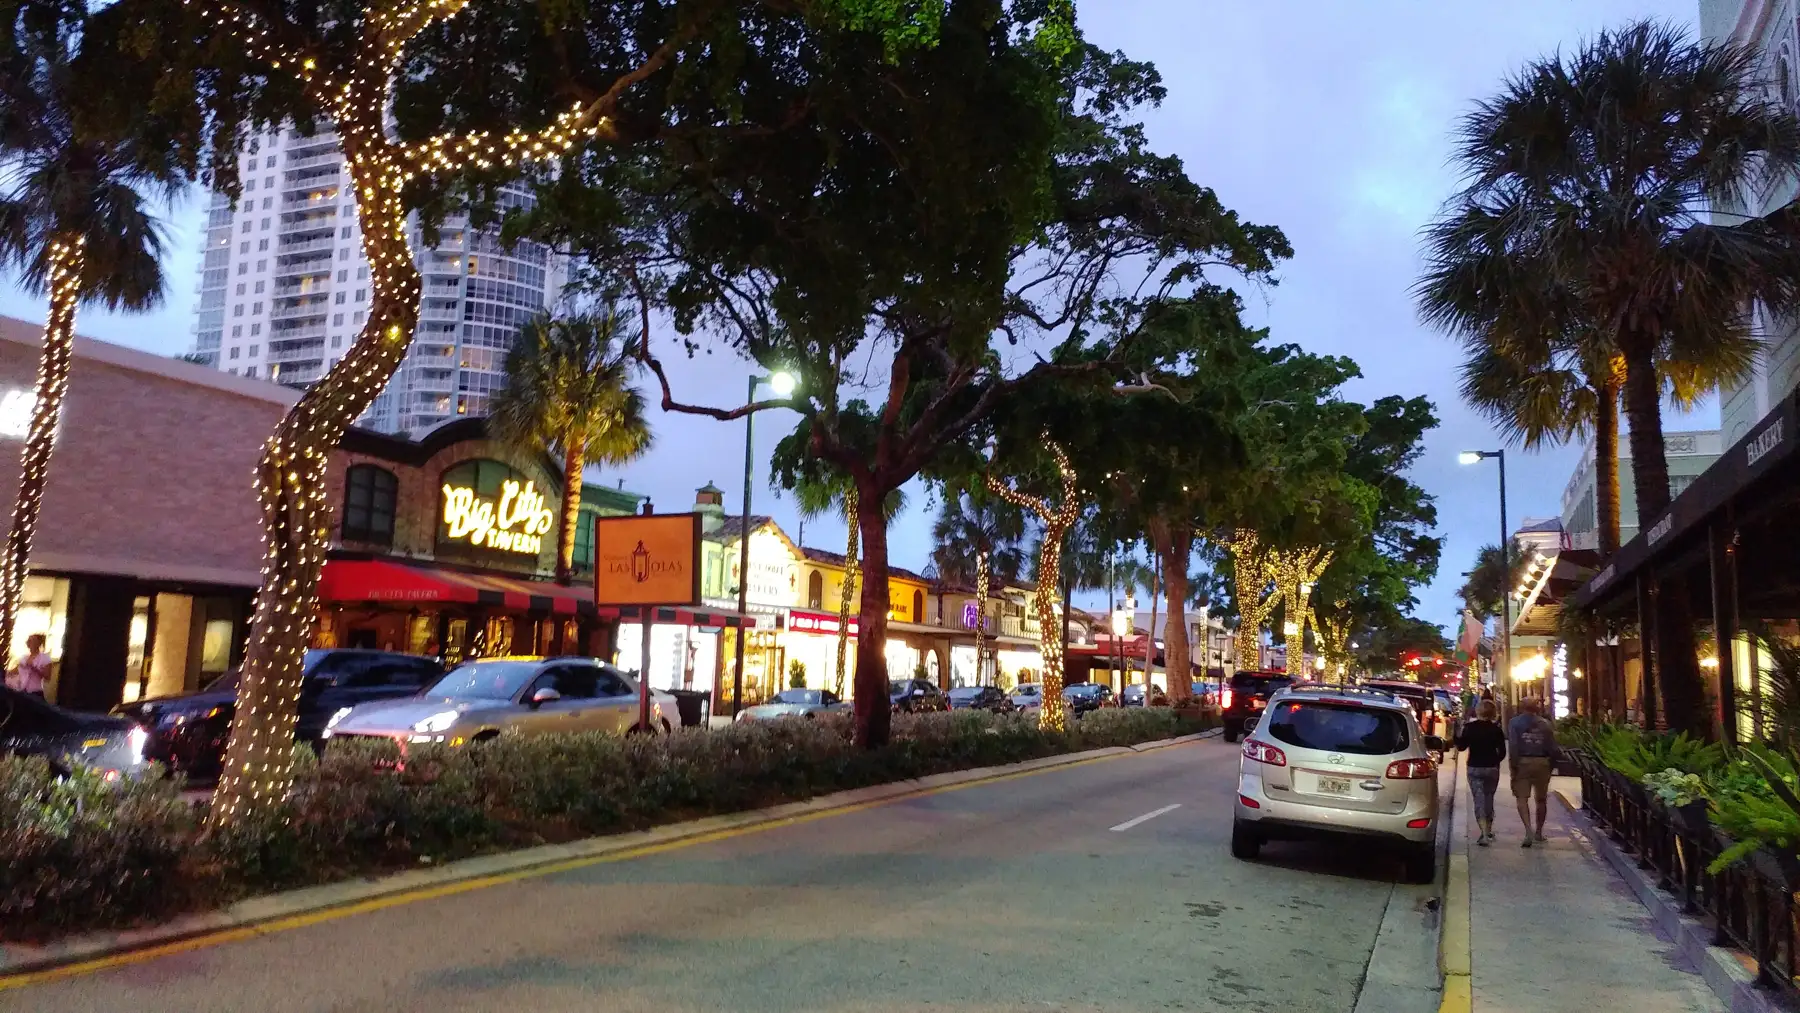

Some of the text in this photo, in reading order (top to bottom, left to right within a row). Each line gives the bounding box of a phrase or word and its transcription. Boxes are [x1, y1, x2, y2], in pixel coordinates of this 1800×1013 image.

[1746, 416, 1784, 467] BAKERY
[442, 479, 554, 545] Big City
[487, 528, 541, 554] TAVERN
[609, 560, 683, 573] LAS OLAS
